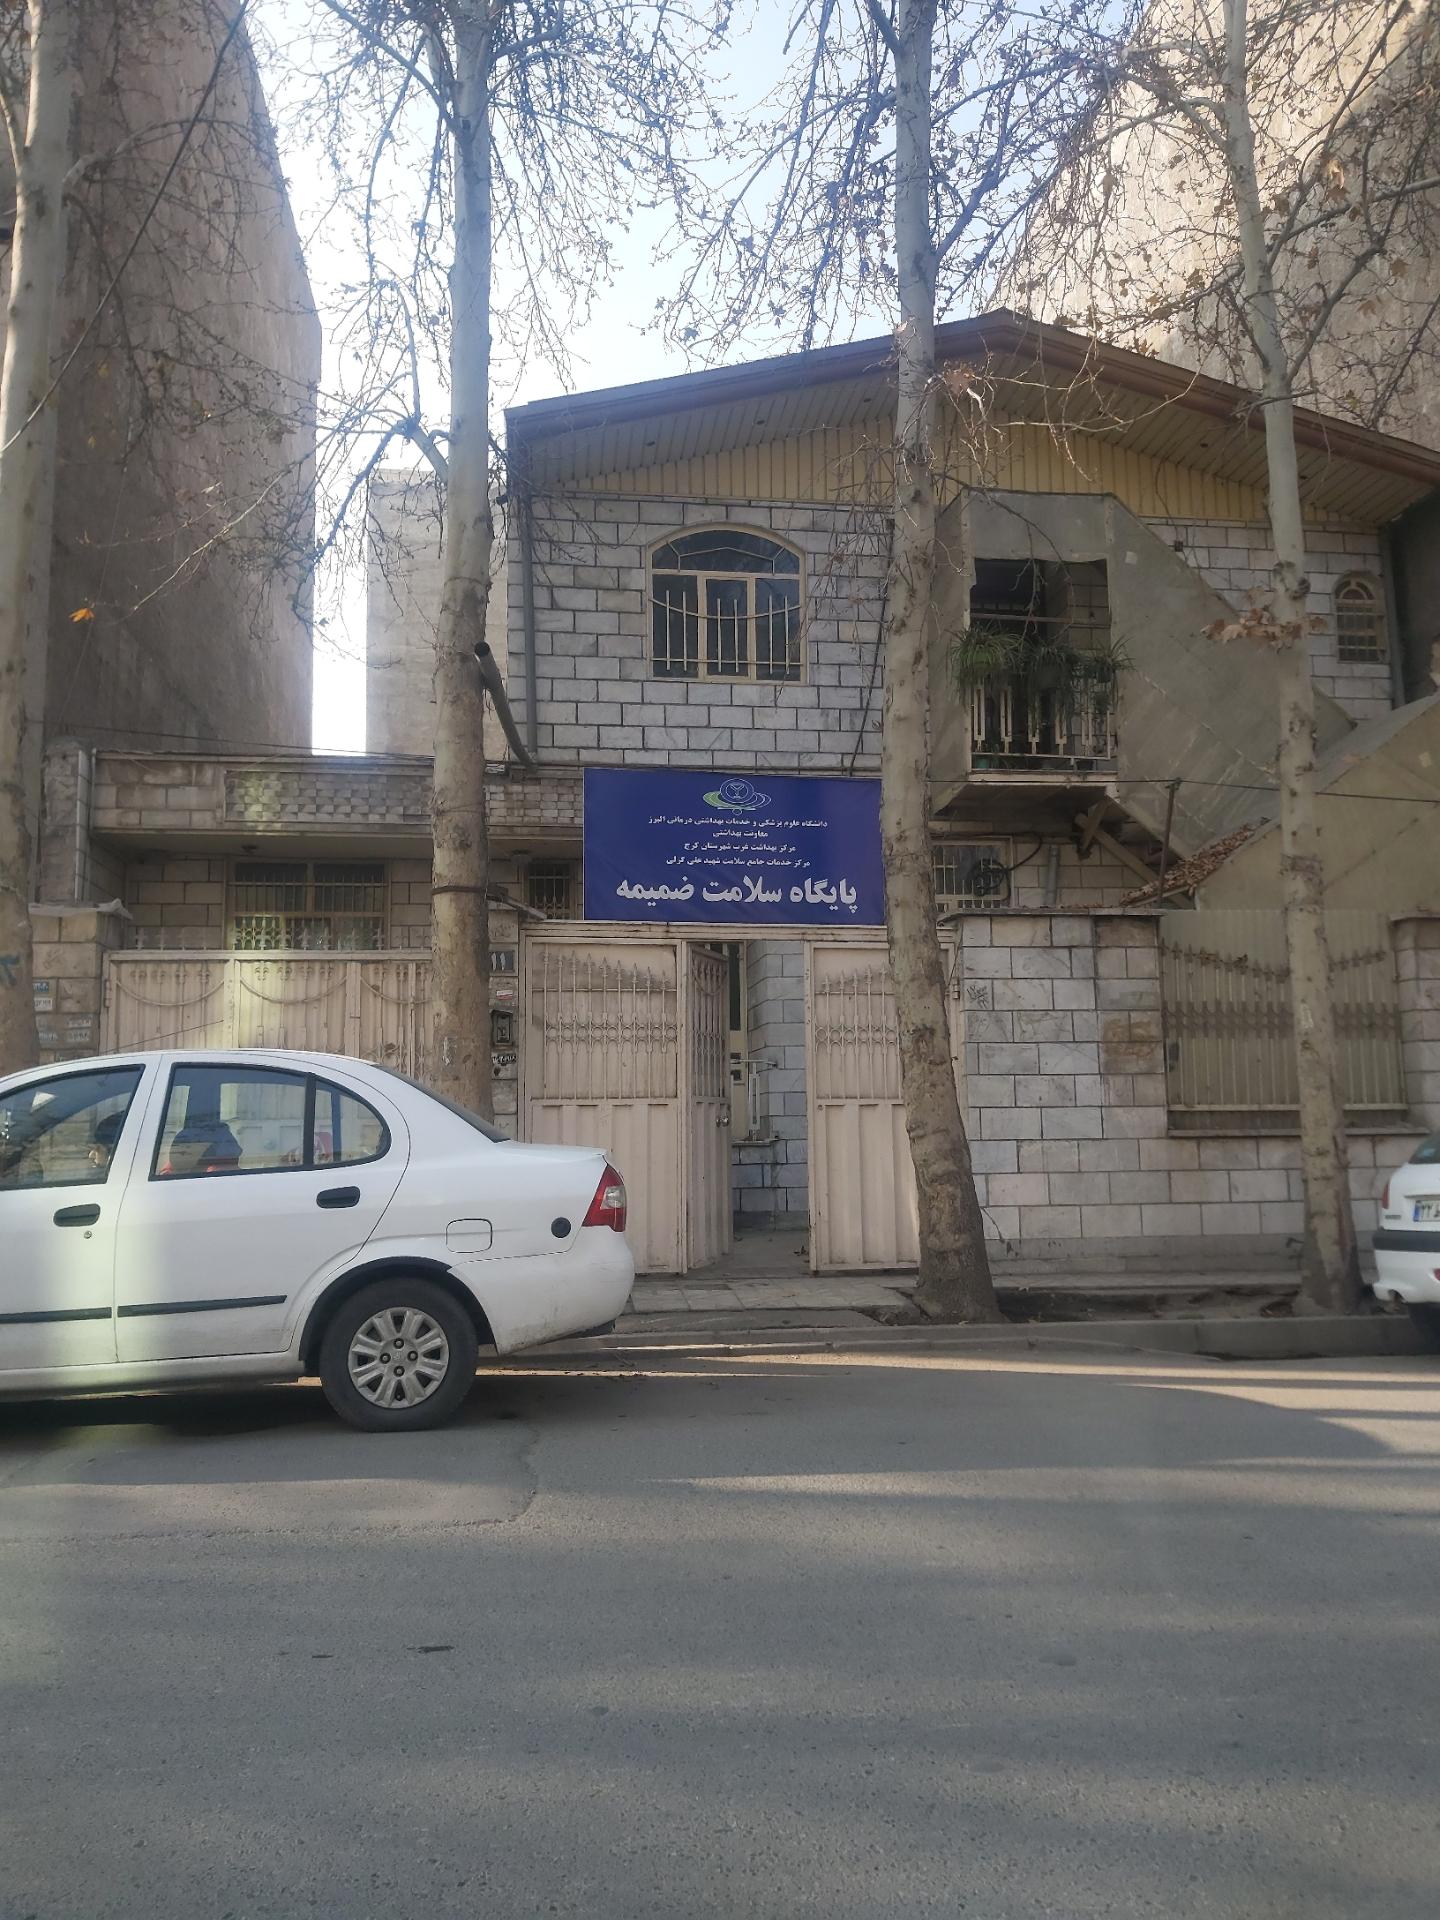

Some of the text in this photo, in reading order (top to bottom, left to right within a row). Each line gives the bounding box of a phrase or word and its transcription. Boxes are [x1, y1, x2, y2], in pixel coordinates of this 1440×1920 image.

[648, 815, 666, 824] البرز
[667, 815, 693, 825] درمانی
[694, 817, 724, 826] بهداشتی
[726, 818, 751, 826] خدمات
[758, 819, 783, 828] پزشکی
[783, 819, 800, 828] علوم
[712, 828, 769, 839] معاونت بهداشتی
[684, 841, 796, 853] مرکز بهداشت غرب شهرستان کرج
[686, 856, 702, 866] علی
[703, 857, 721, 866] شهید
[722, 856, 746, 865] سلامت
[746, 857, 765, 867] جامع
[766, 858, 792, 867] خدمات
[793, 858, 811, 868] مرکز
[616, 874, 858, 914] پایگاه سلامت ضمیمه
